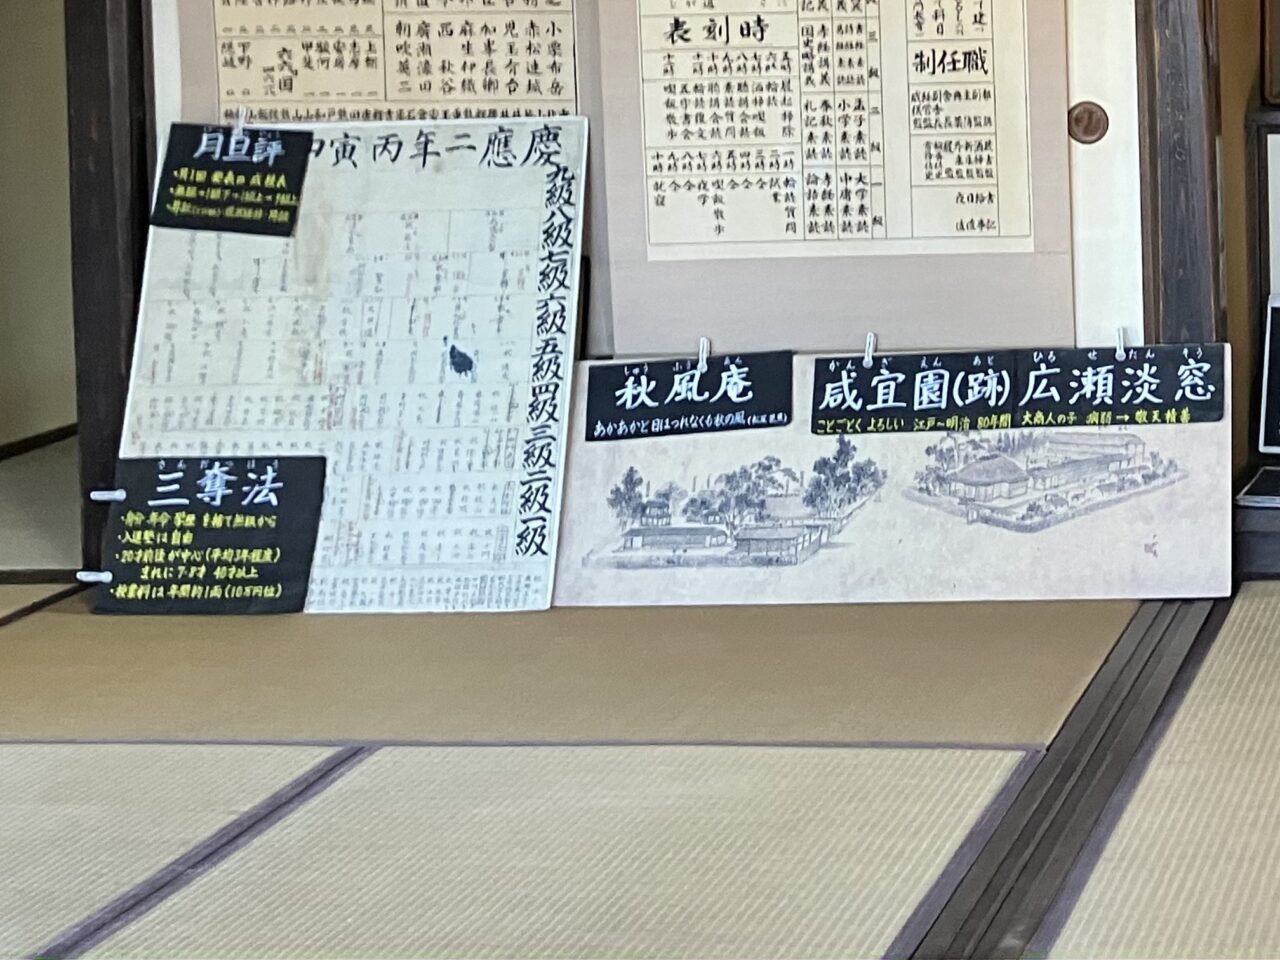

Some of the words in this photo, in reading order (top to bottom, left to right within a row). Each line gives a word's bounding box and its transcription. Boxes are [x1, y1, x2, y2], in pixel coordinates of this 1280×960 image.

[545, 163, 576, 209] 九級
[541, 207, 574, 250] 八級
[537, 250, 570, 292] 七級
[535, 293, 568, 337] 六級
[531, 337, 564, 382] 五級
[526, 382, 560, 424] 四級
[615, 363, 754, 411] 秋風庵
[818, 367, 1012, 412] 咸宜園(跡)
[1018, 357, 1216, 408] 広瀬淡窓
[521, 424, 556, 469] 三級
[817, 417, 863, 435] ことごとく
[866, 416, 906, 433] よろしい
[976, 413, 1013, 431] 80年間
[147, 461, 284, 507] 三奪法
[518, 470, 552, 515] 二級
[515, 515, 549, 557] 一級
